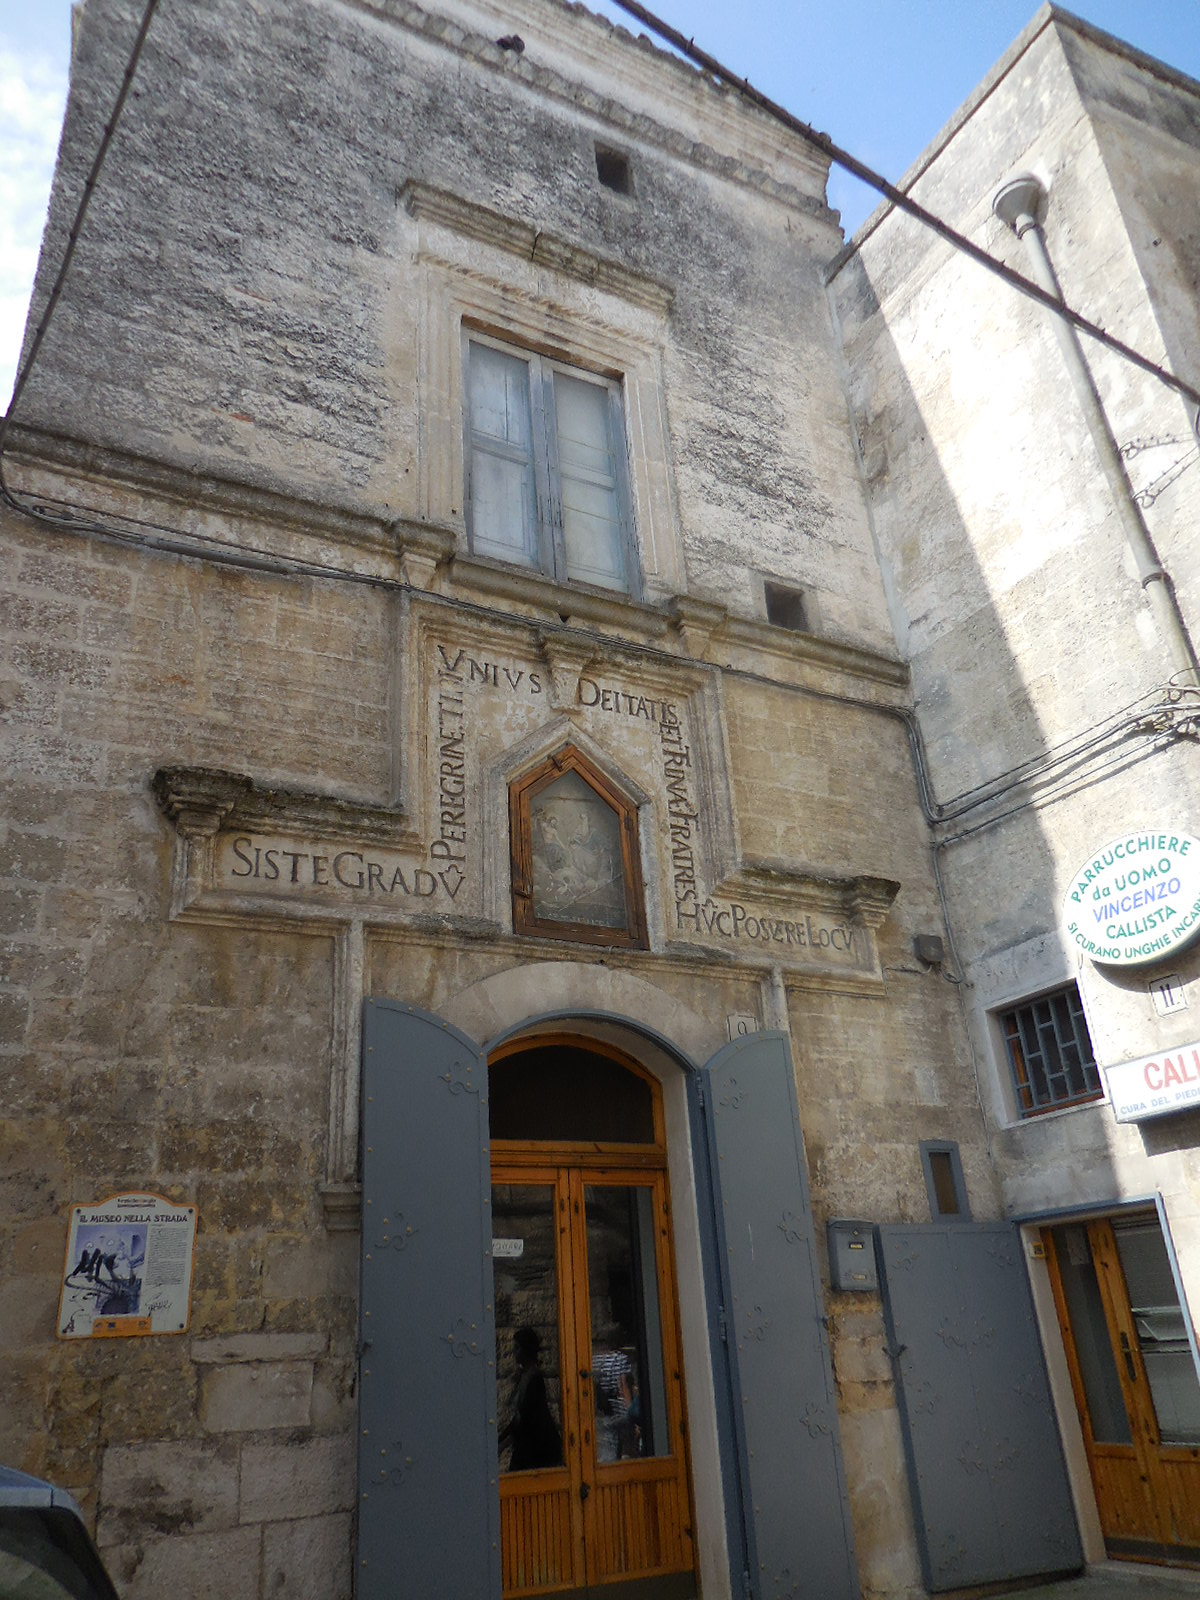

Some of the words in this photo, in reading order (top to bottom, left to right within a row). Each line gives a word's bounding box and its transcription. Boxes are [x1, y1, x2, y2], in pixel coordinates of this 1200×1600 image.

[437, 644, 542, 694] VNIVS
[232, 836, 329, 886] SISTE
[668, 808, 699, 902] FRATRES
[1071, 835, 1191, 904] PARRUCCHIERE
[1092, 885, 1111, 901] da
[1115, 857, 1172, 892] UOMO
[1092, 877, 1181, 923] VINCENZO
[1067, 921, 1079, 935] SI
[1075, 933, 1121, 959] CURANO
[1124, 933, 1172, 959] UNGHIE
[1106, 905, 1177, 939] CALLISTA
[1120, 1102, 1148, 1116] CURA
[1150, 1096, 1171, 1107] DEL
[79, 1214, 88, 1223] IL
[89, 1213, 122, 1223] MUSEO
[123, 1213, 151, 1223] NELLA
[153, 1214, 188, 1223] STRADA
